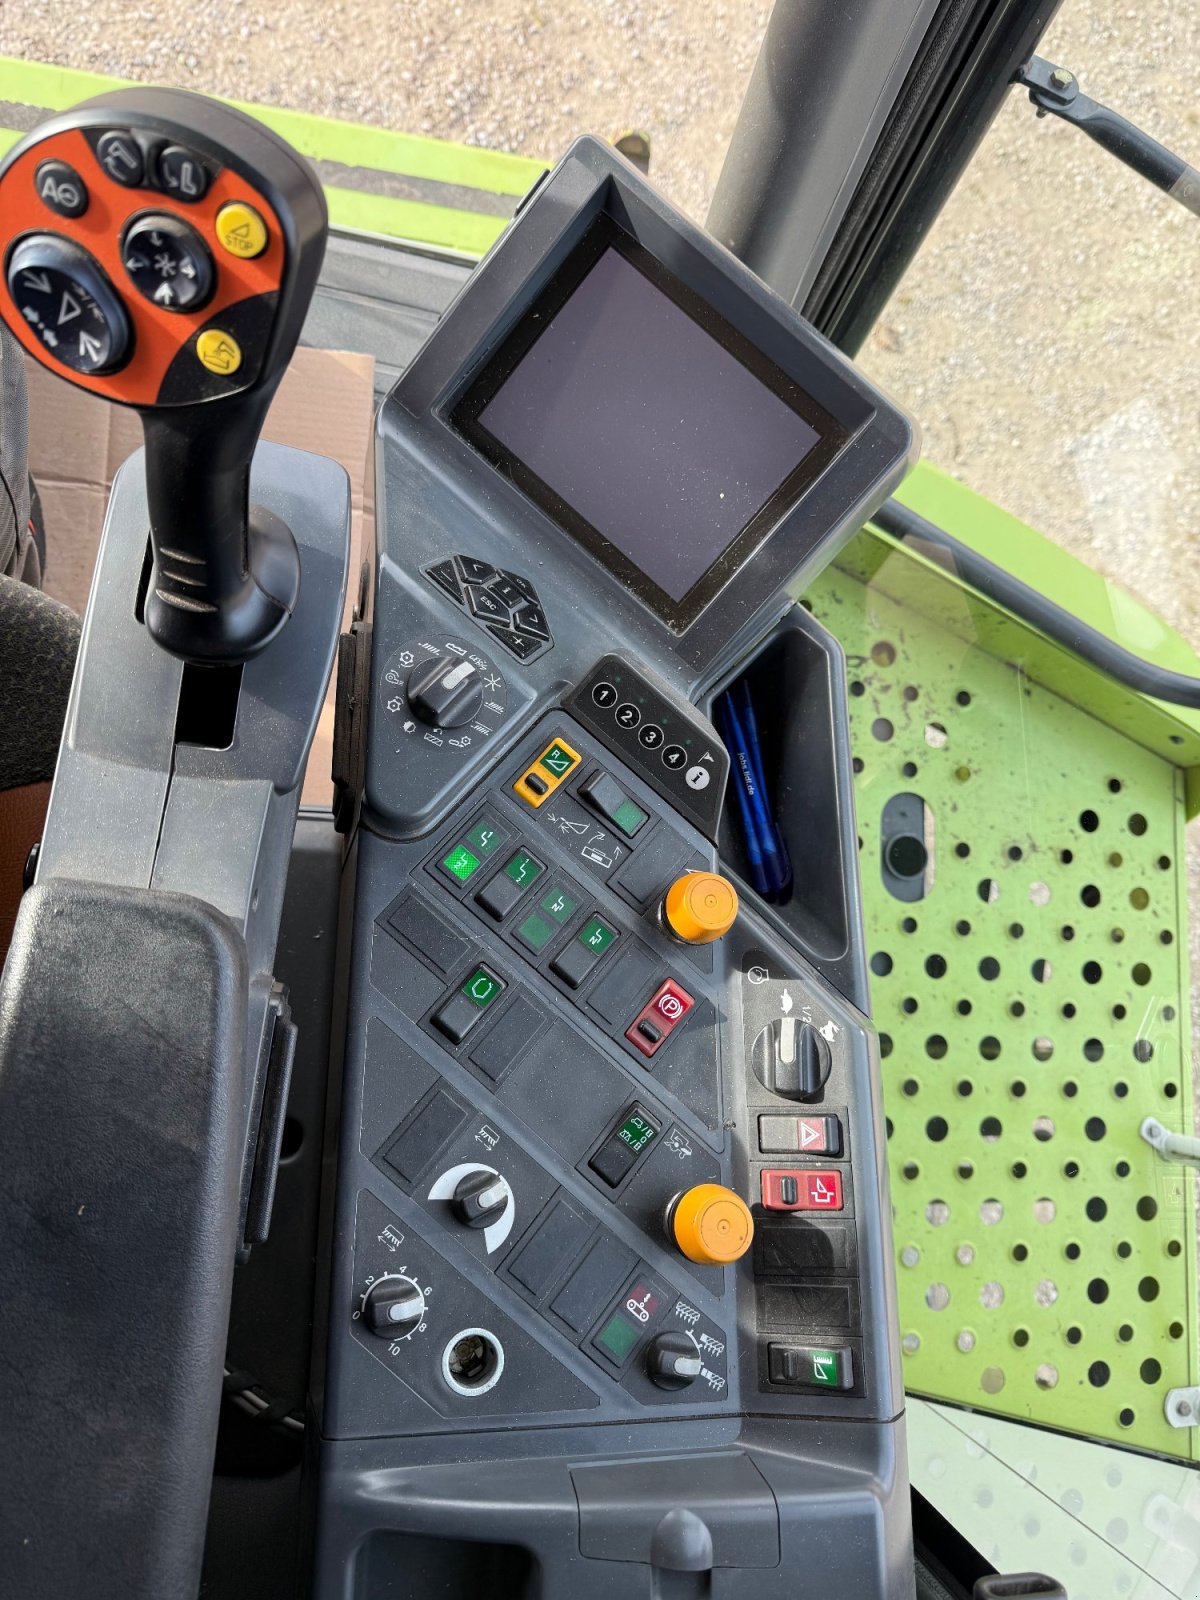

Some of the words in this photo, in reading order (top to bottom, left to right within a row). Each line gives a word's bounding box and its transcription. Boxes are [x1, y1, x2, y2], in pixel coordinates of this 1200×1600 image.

[224, 234, 254, 250] STOP
[480, 596, 497, 611] ESC
[600, 690, 609, 701] 1
[621, 710, 633, 723] 2
[645, 731, 657, 743] 3
[551, 749, 561, 759] R
[668, 752, 681, 763] 4
[399, 1265, 408, 1273] 4
[365, 1276, 375, 1286] 2
[424, 1286, 433, 1296] 6
[352, 1311, 361, 1320] 0
[418, 1322, 427, 1333] 8
[387, 1342, 401, 1356] 10
